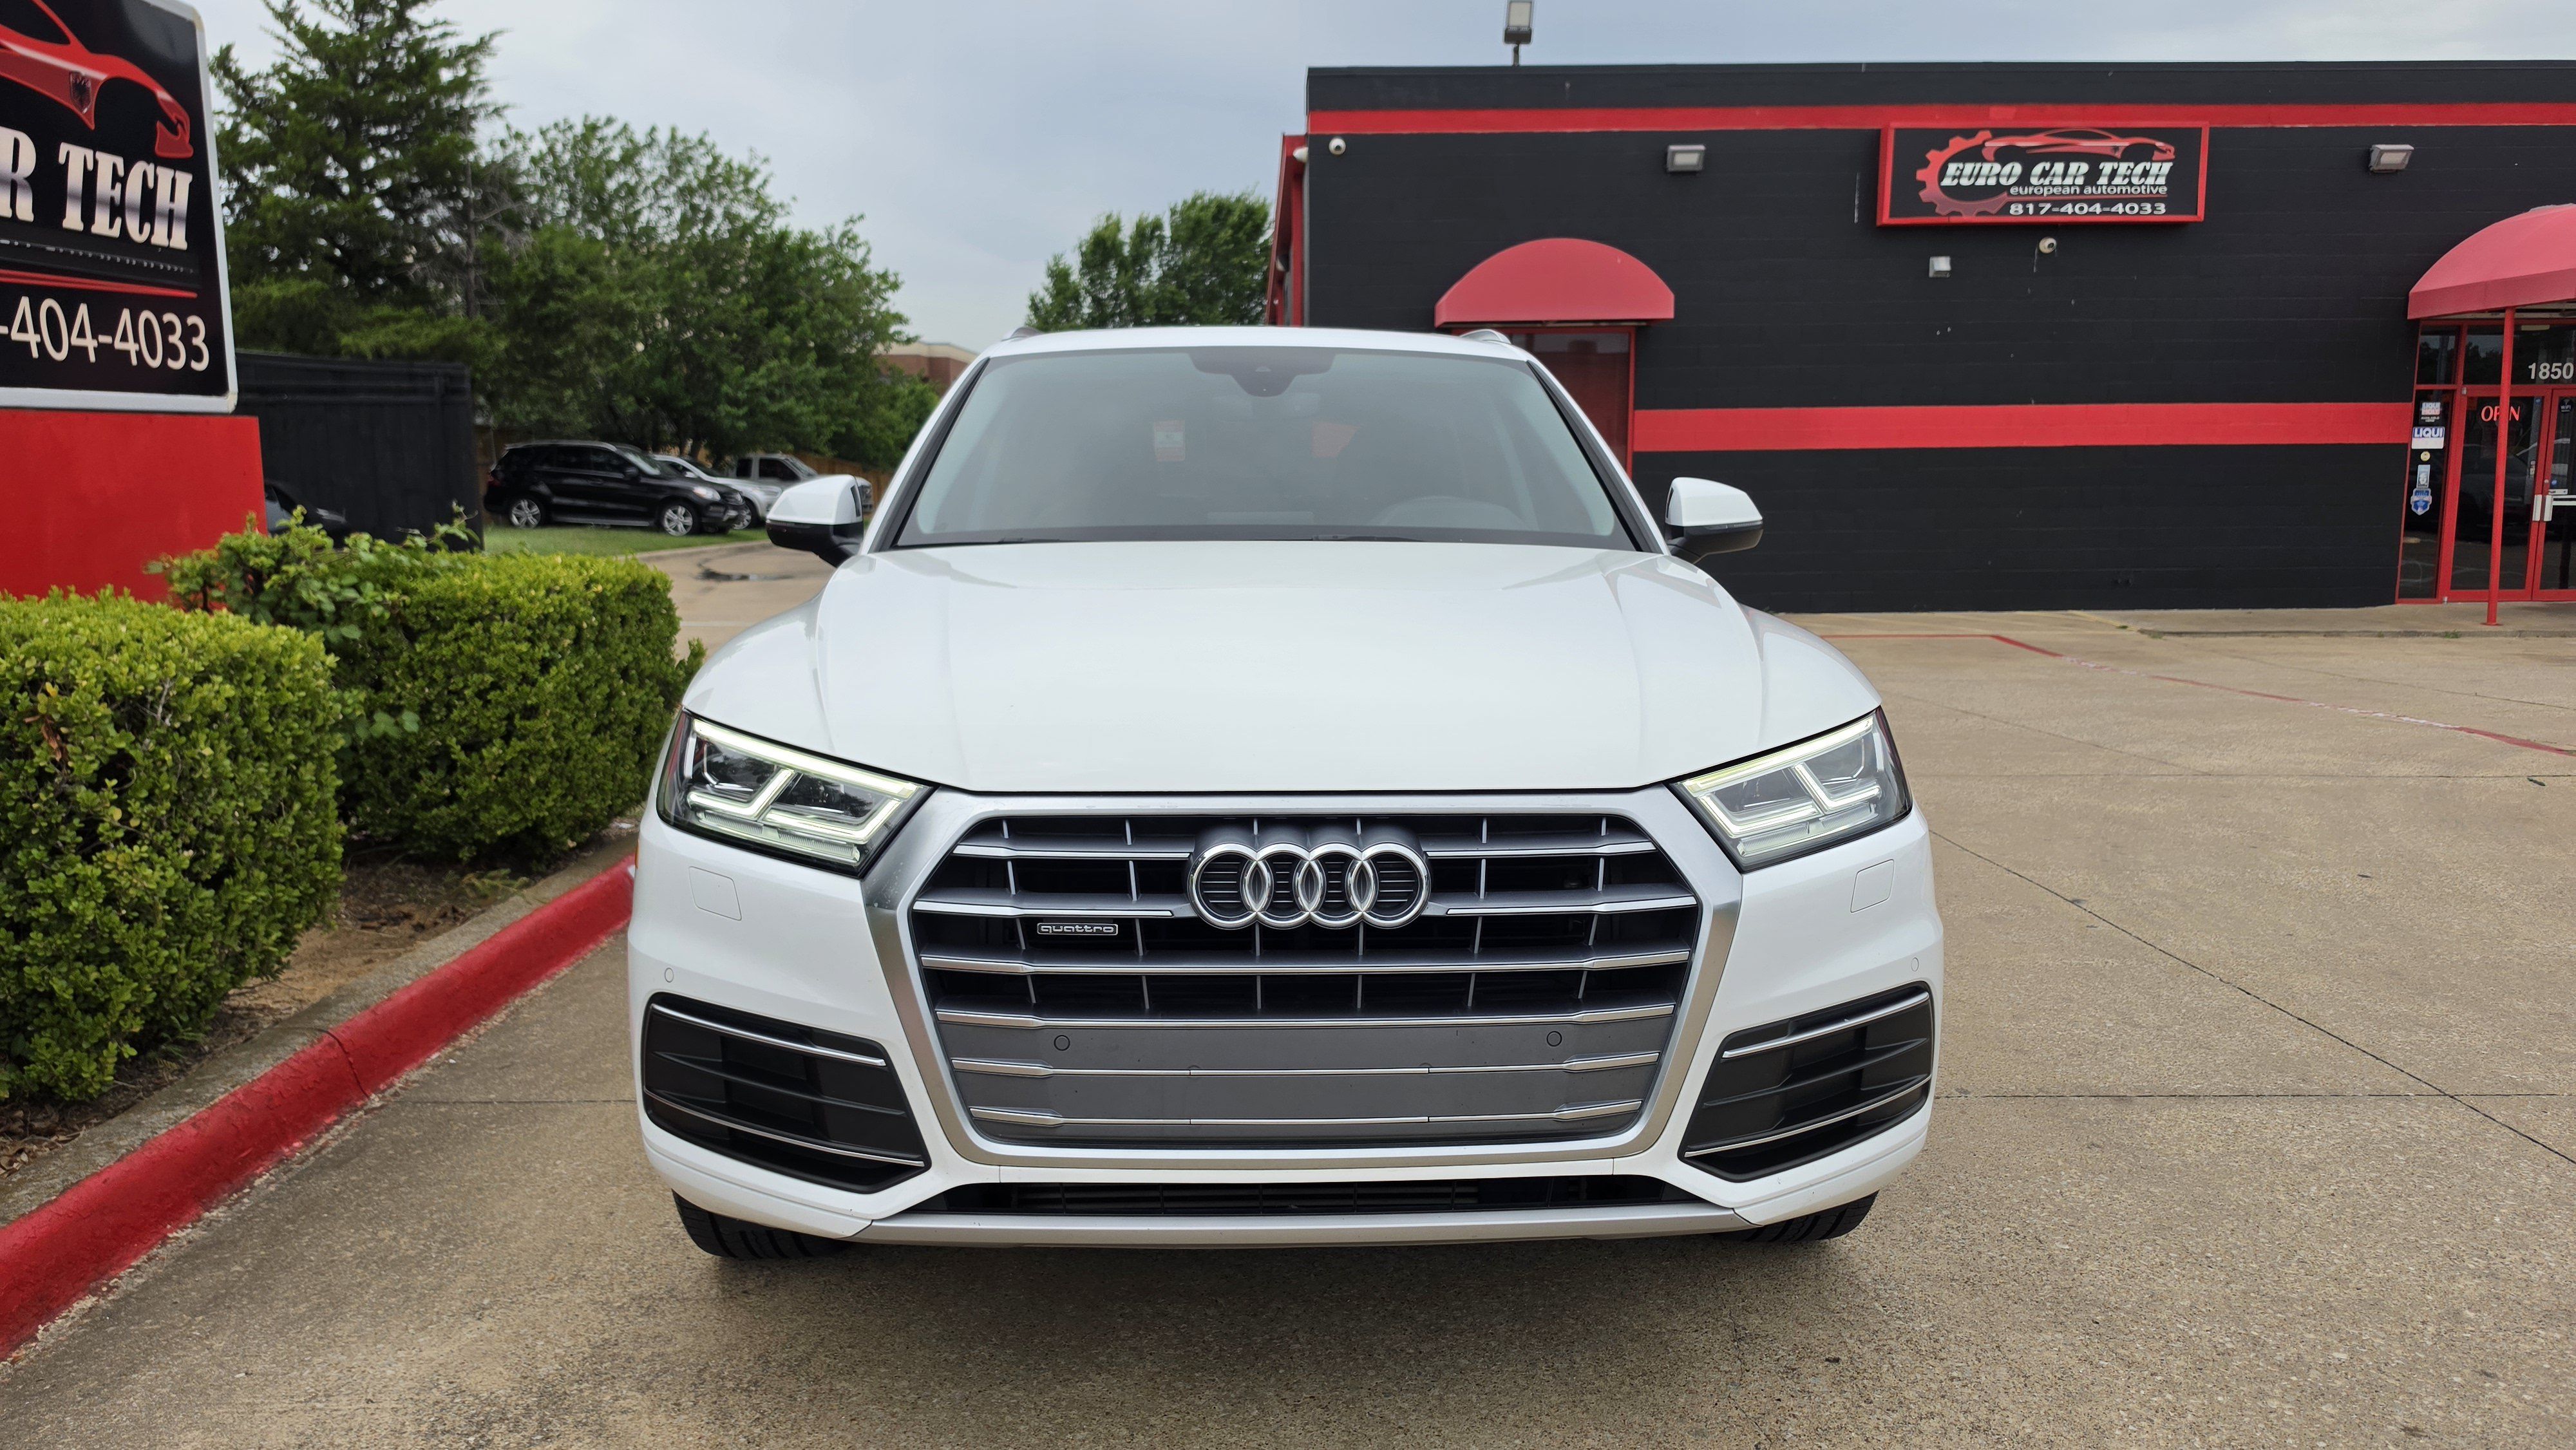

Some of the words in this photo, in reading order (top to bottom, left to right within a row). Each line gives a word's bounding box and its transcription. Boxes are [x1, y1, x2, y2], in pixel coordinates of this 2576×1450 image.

[1940, 161, 2022, 186] EURO
[2030, 161, 2089, 185] CAR
[2096, 161, 2174, 185] TECH
[59, 142, 193, 250] TECH
[2010, 185, 2079, 197] european
[2083, 184, 2168, 194] automotive
[2009, 203, 2166, 215] 817-404-4033
[2528, 362, 2574, 379] 1850
[2481, 406, 2520, 422] OPN
[2414, 427, 2443, 438] LIQUI
[1041, 925, 1114, 934] quattro
